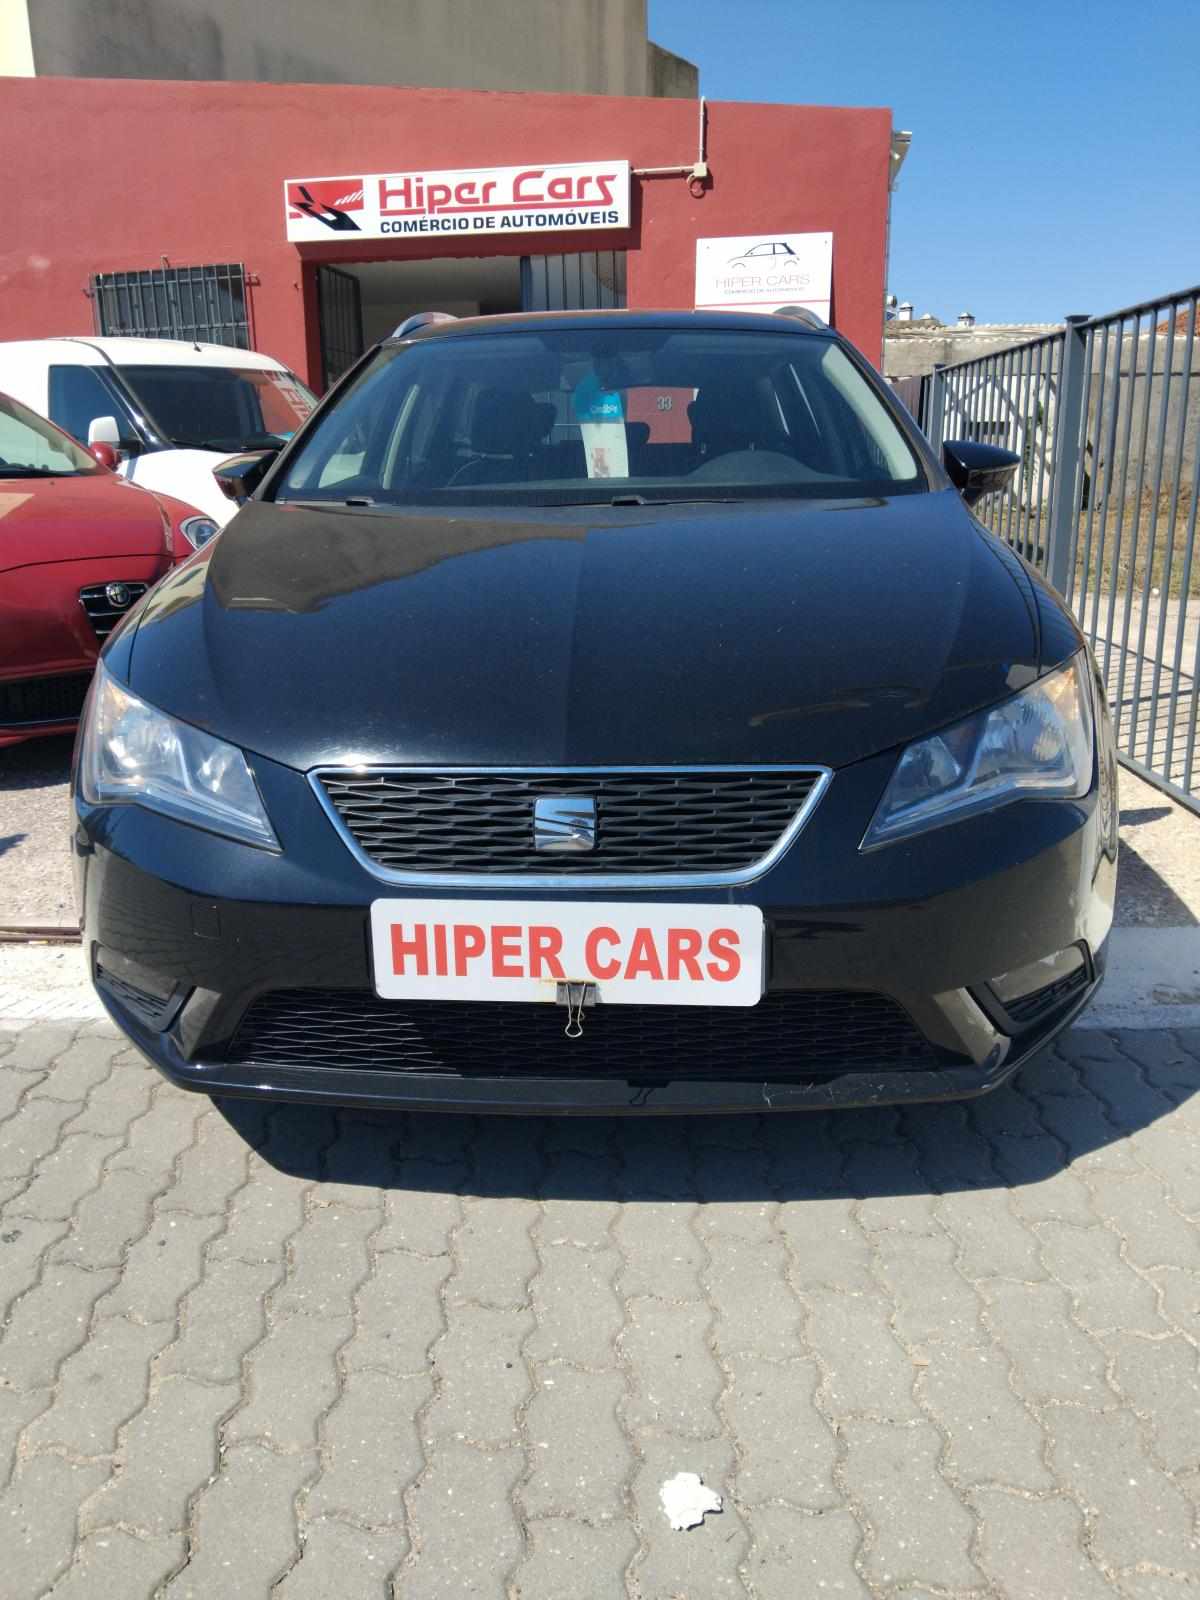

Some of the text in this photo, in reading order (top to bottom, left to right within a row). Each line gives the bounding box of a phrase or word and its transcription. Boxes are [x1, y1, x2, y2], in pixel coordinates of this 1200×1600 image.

[378, 170, 617, 214] Hiper Cars
[380, 209, 619, 233] COMÉRCIO DE AUTOMÓVEIS
[715, 274, 811, 288] HIPER CARS
[390, 923, 741, 982] HIPER CARS
